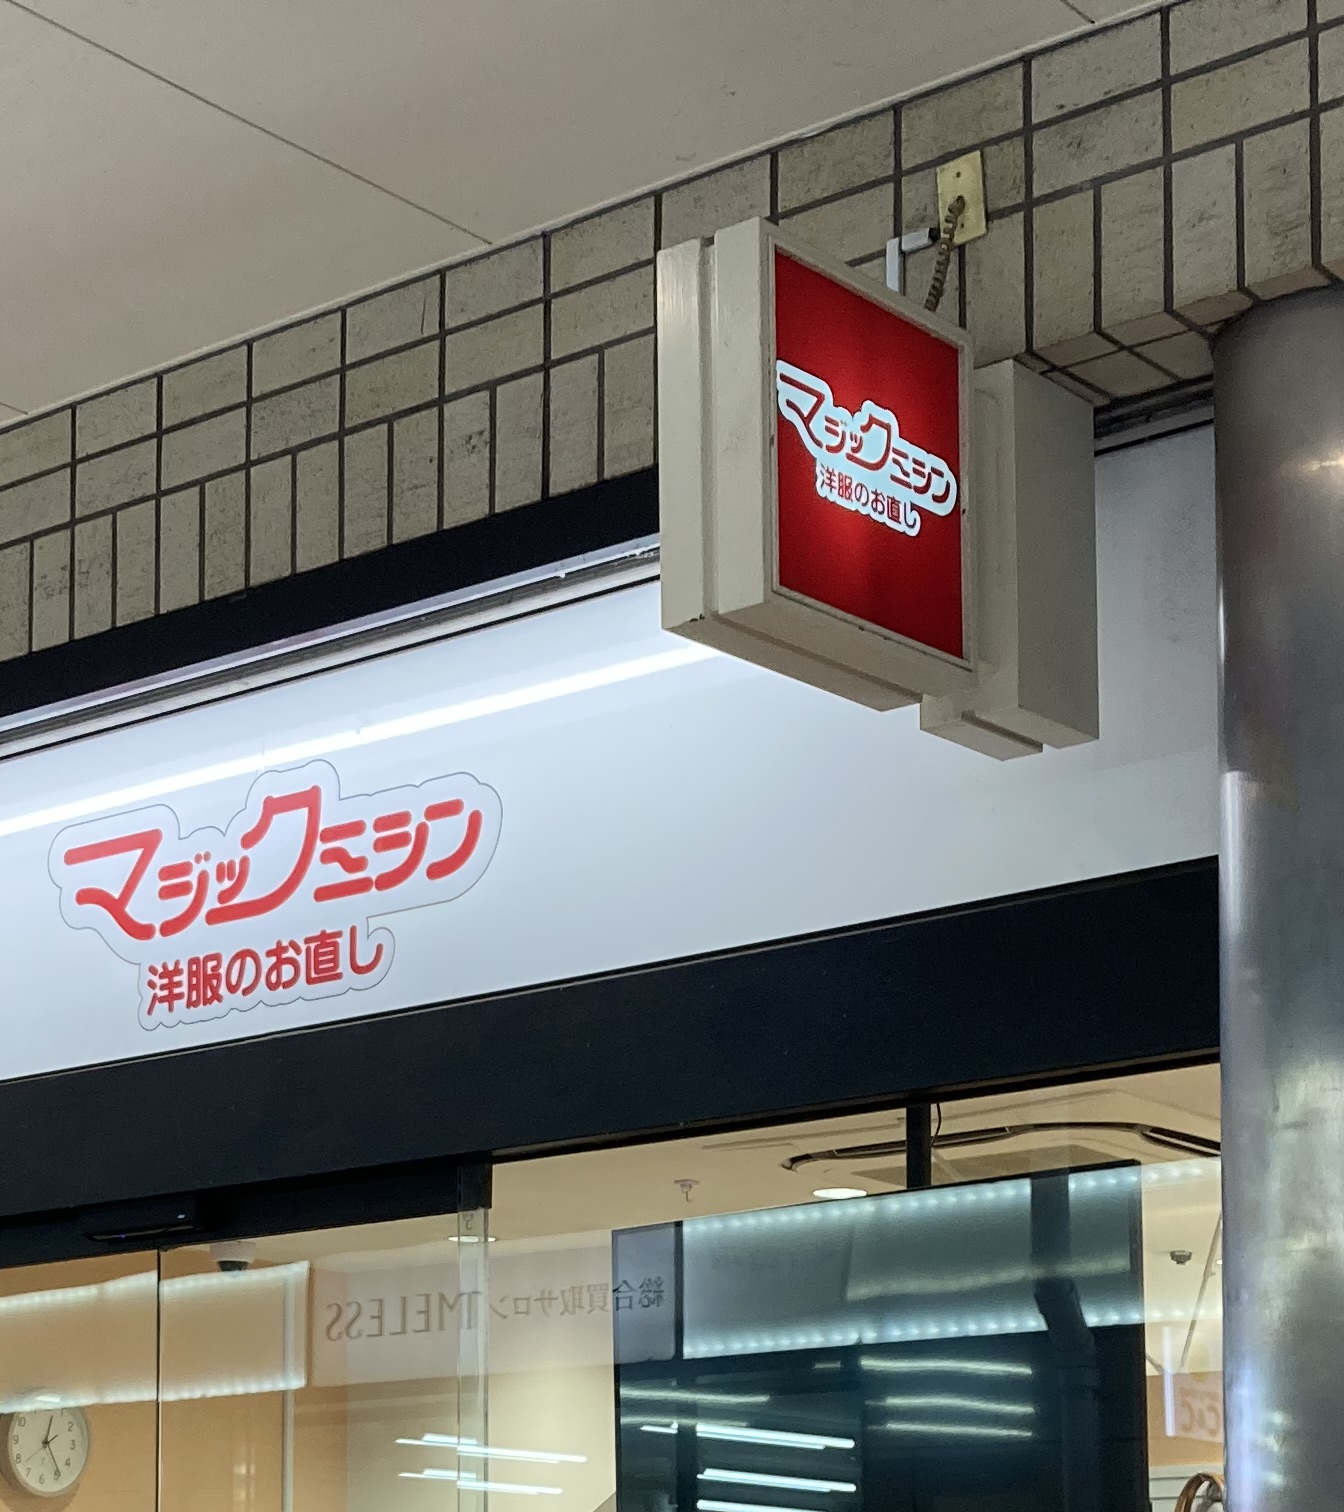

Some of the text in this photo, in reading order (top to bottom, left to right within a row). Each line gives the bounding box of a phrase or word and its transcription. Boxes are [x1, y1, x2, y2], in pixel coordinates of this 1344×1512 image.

[779, 372, 952, 505] マジックミシン
[818, 462, 918, 529] 洋服のお直し
[62, 784, 484, 942] マジックミシン
[146, 924, 384, 1017] 洋服のお直し
